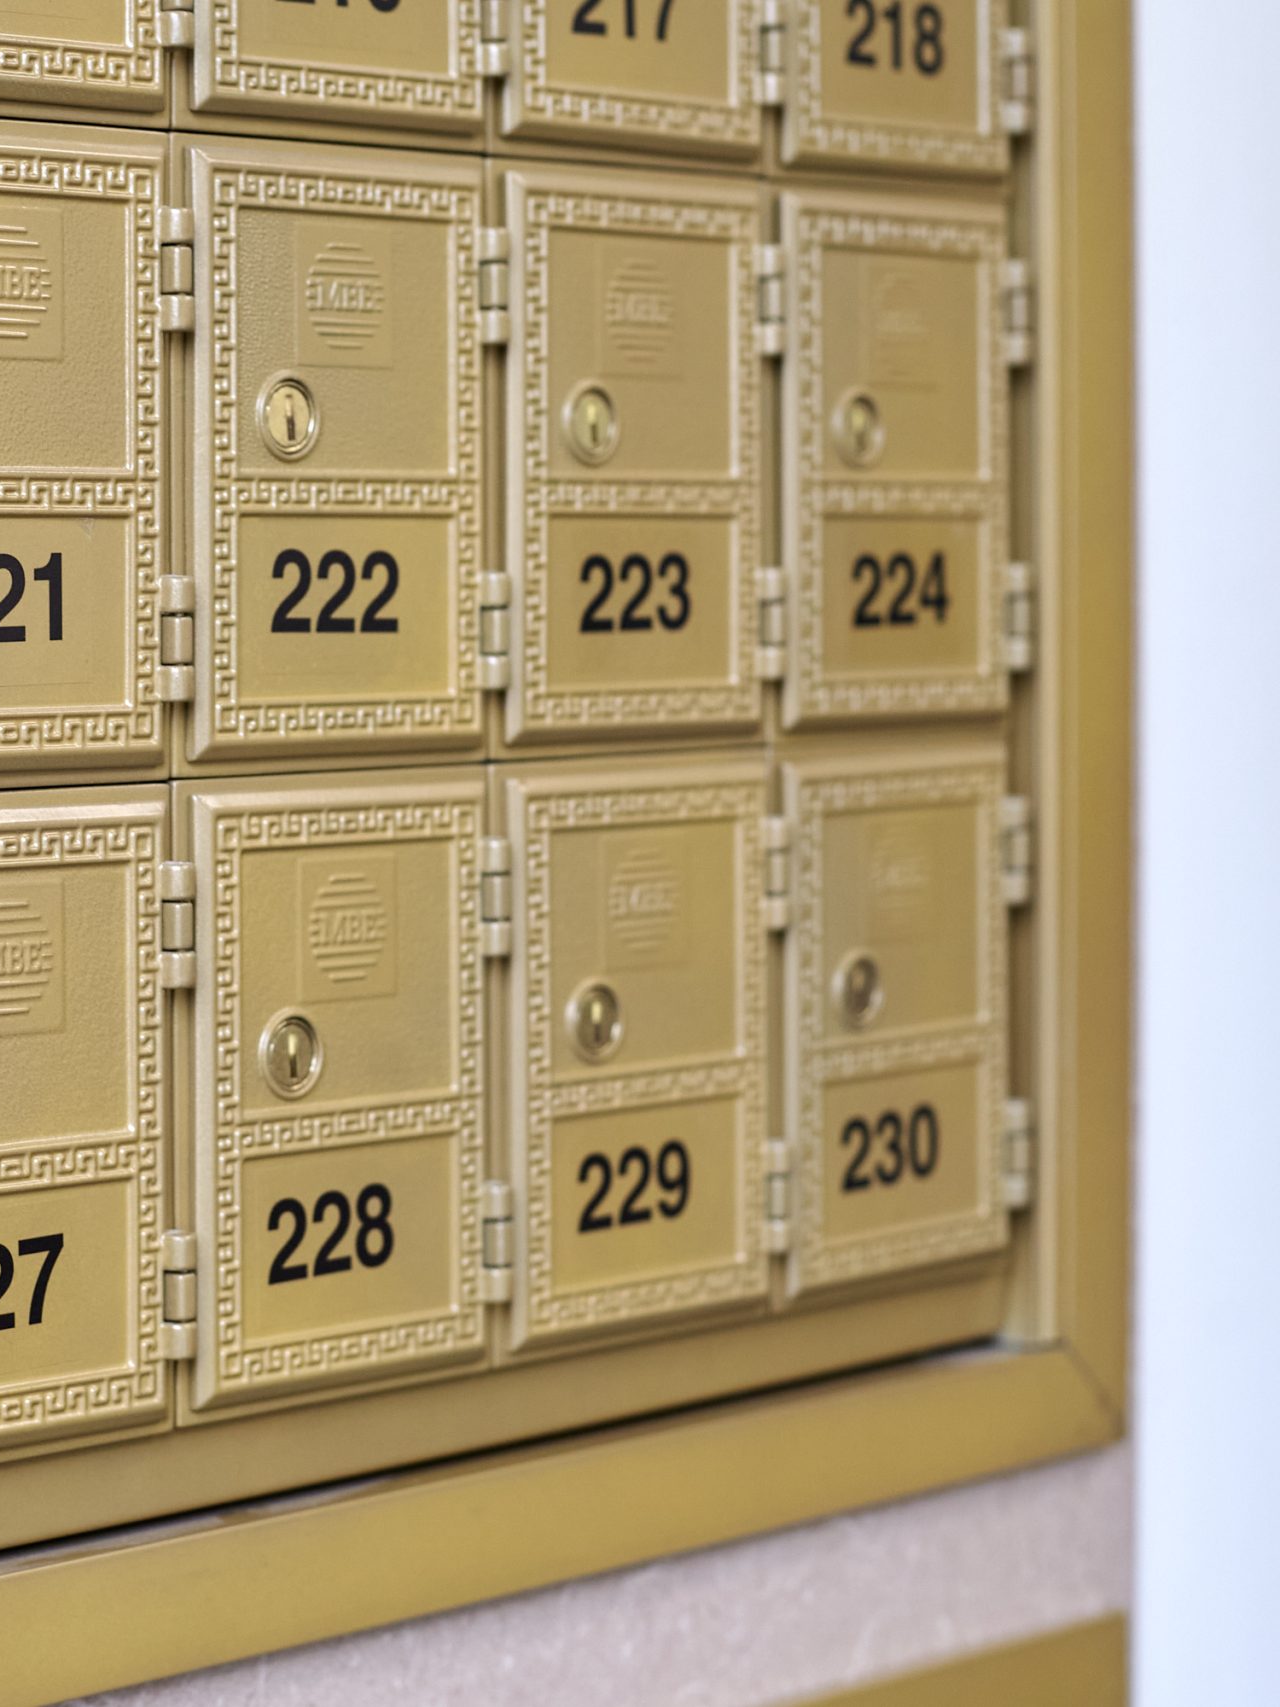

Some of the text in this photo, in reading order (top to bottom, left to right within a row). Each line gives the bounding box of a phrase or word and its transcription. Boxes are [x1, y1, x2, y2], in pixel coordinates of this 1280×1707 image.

[845, 0, 945, 77] 218
[270, 548, 399, 634] 222
[580, 552, 692, 634] 223
[851, 551, 950, 630] 224
[578, 1139, 691, 1234] 229
[841, 1103, 939, 1194] 230
[268, 1182, 395, 1286] 228
